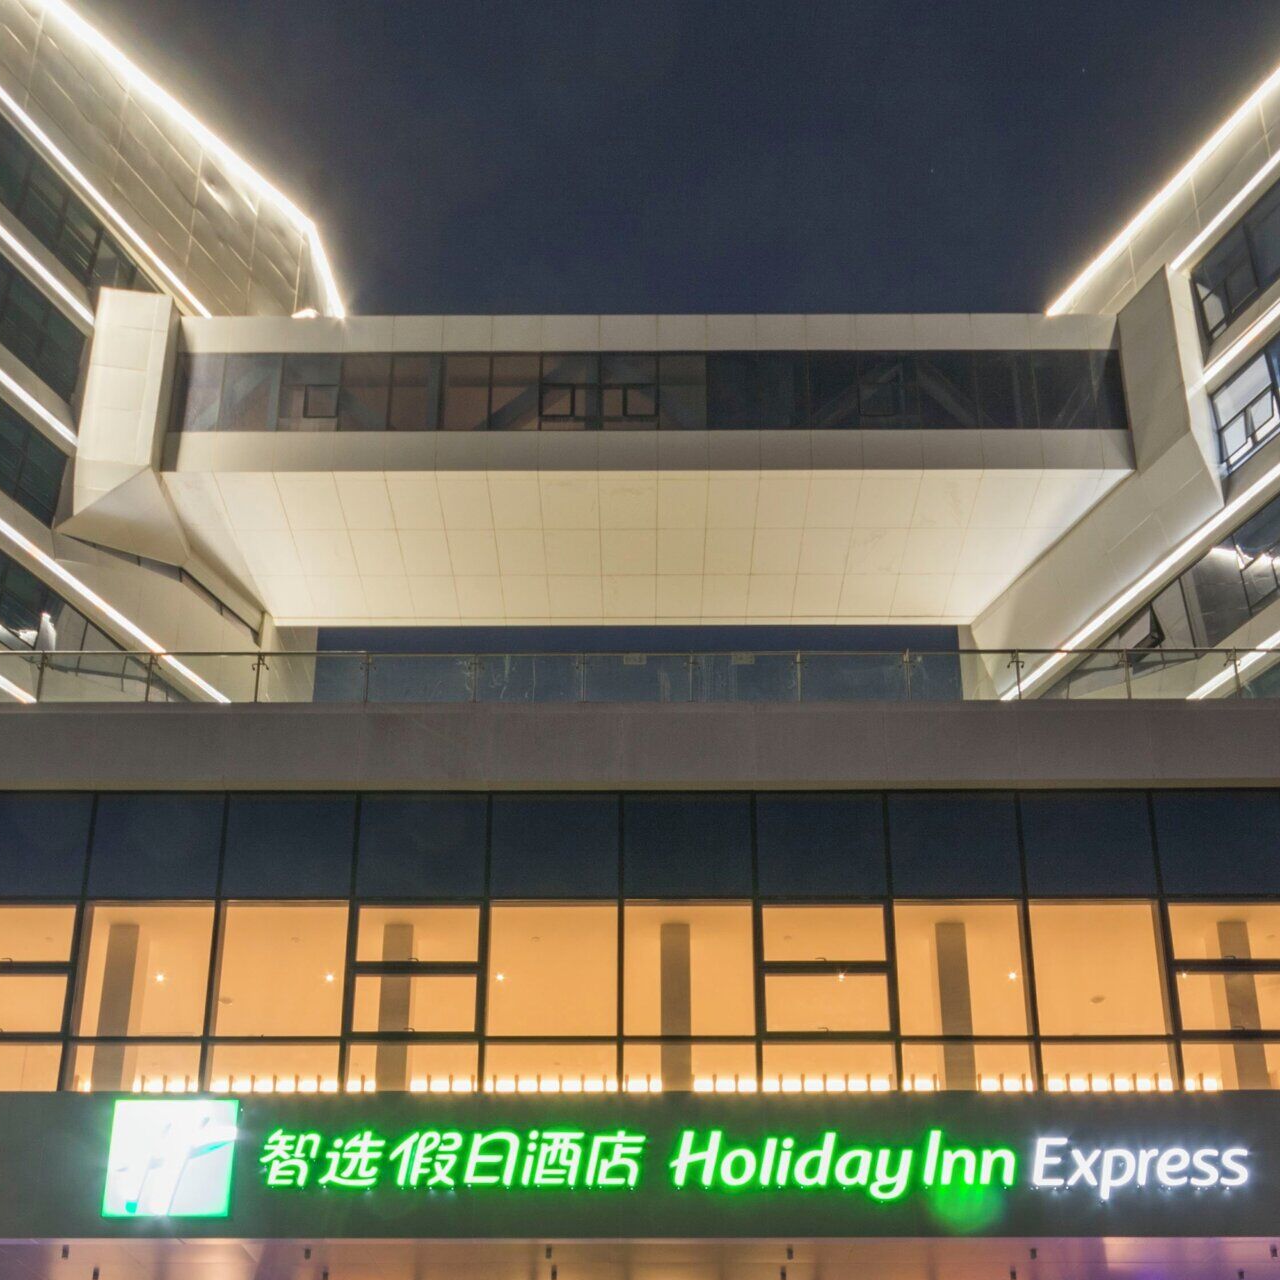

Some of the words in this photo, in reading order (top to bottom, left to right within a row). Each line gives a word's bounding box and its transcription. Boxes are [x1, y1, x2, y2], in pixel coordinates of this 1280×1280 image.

[260, 1129, 646, 1187] 智选假日酒店
[669, 1130, 913, 1200] Holiday
[923, 1130, 1016, 1187] Inn
[1031, 1137, 1250, 1201] Express
